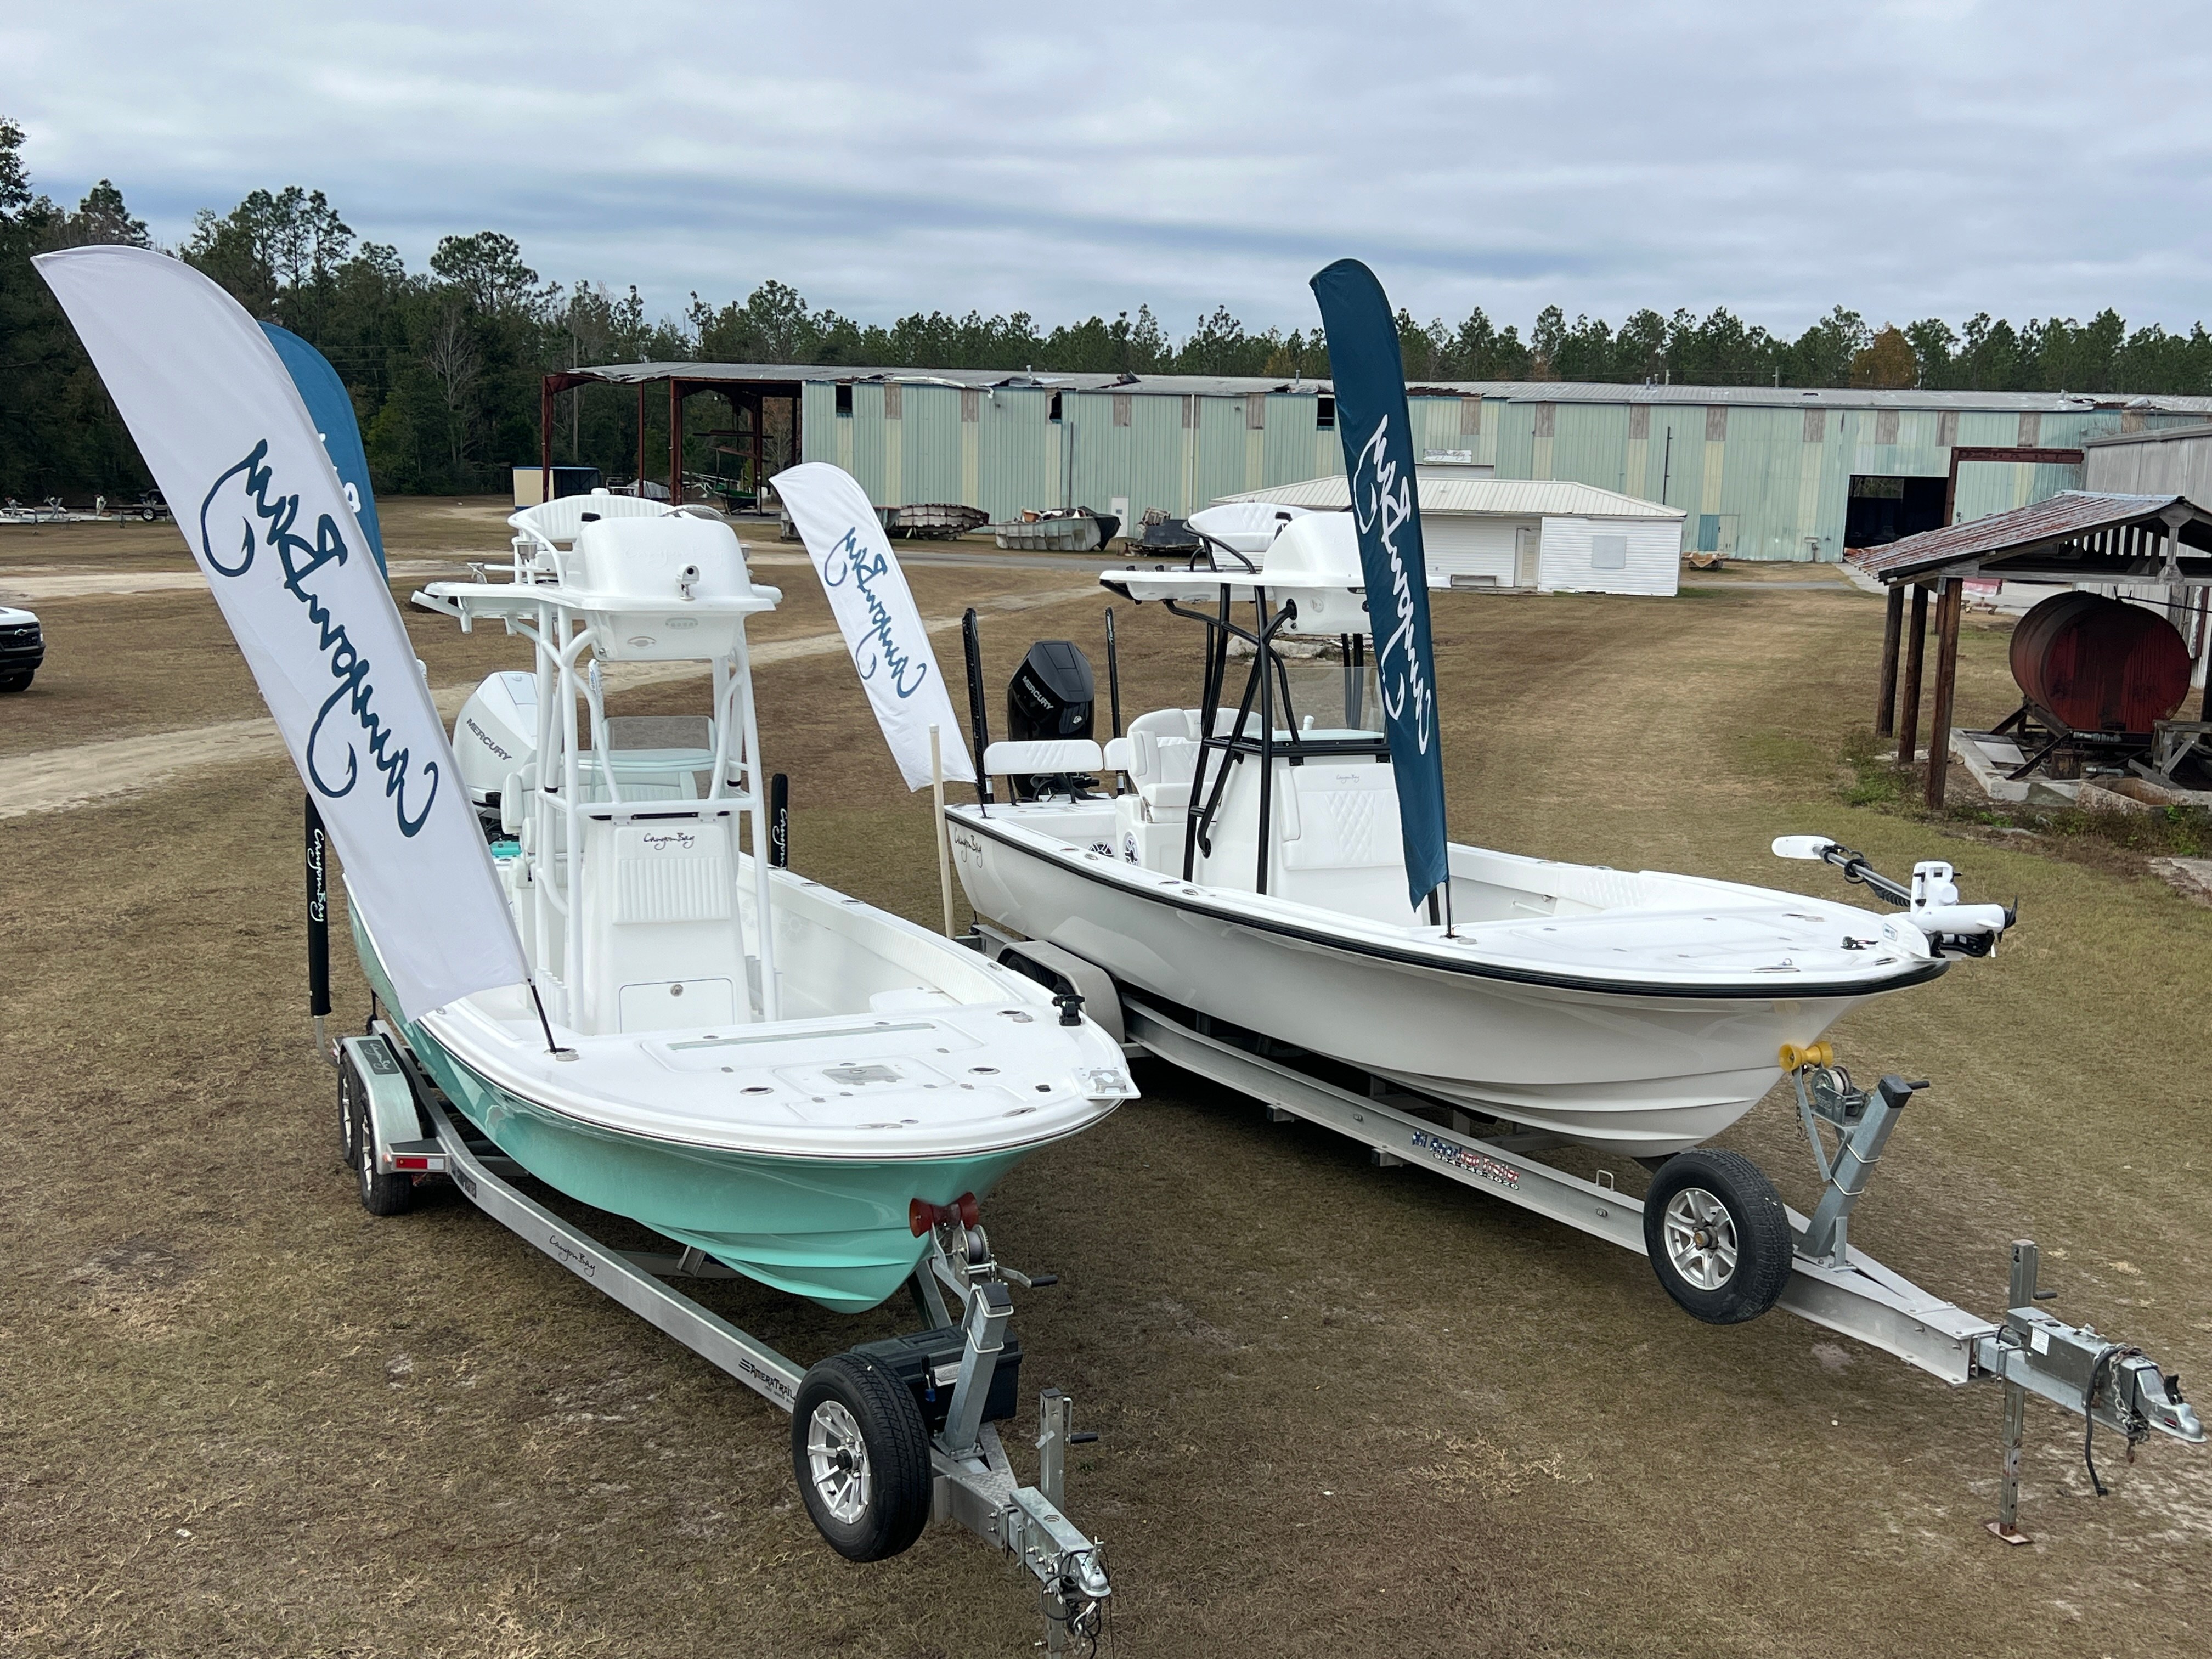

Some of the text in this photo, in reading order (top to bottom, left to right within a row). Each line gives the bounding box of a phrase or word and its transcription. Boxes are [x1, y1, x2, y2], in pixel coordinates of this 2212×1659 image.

[1022, 675, 1054, 710] MERCURY
[466, 718, 513, 761] MERCURY
[549, 1235, 596, 1277] Canyon Bay
